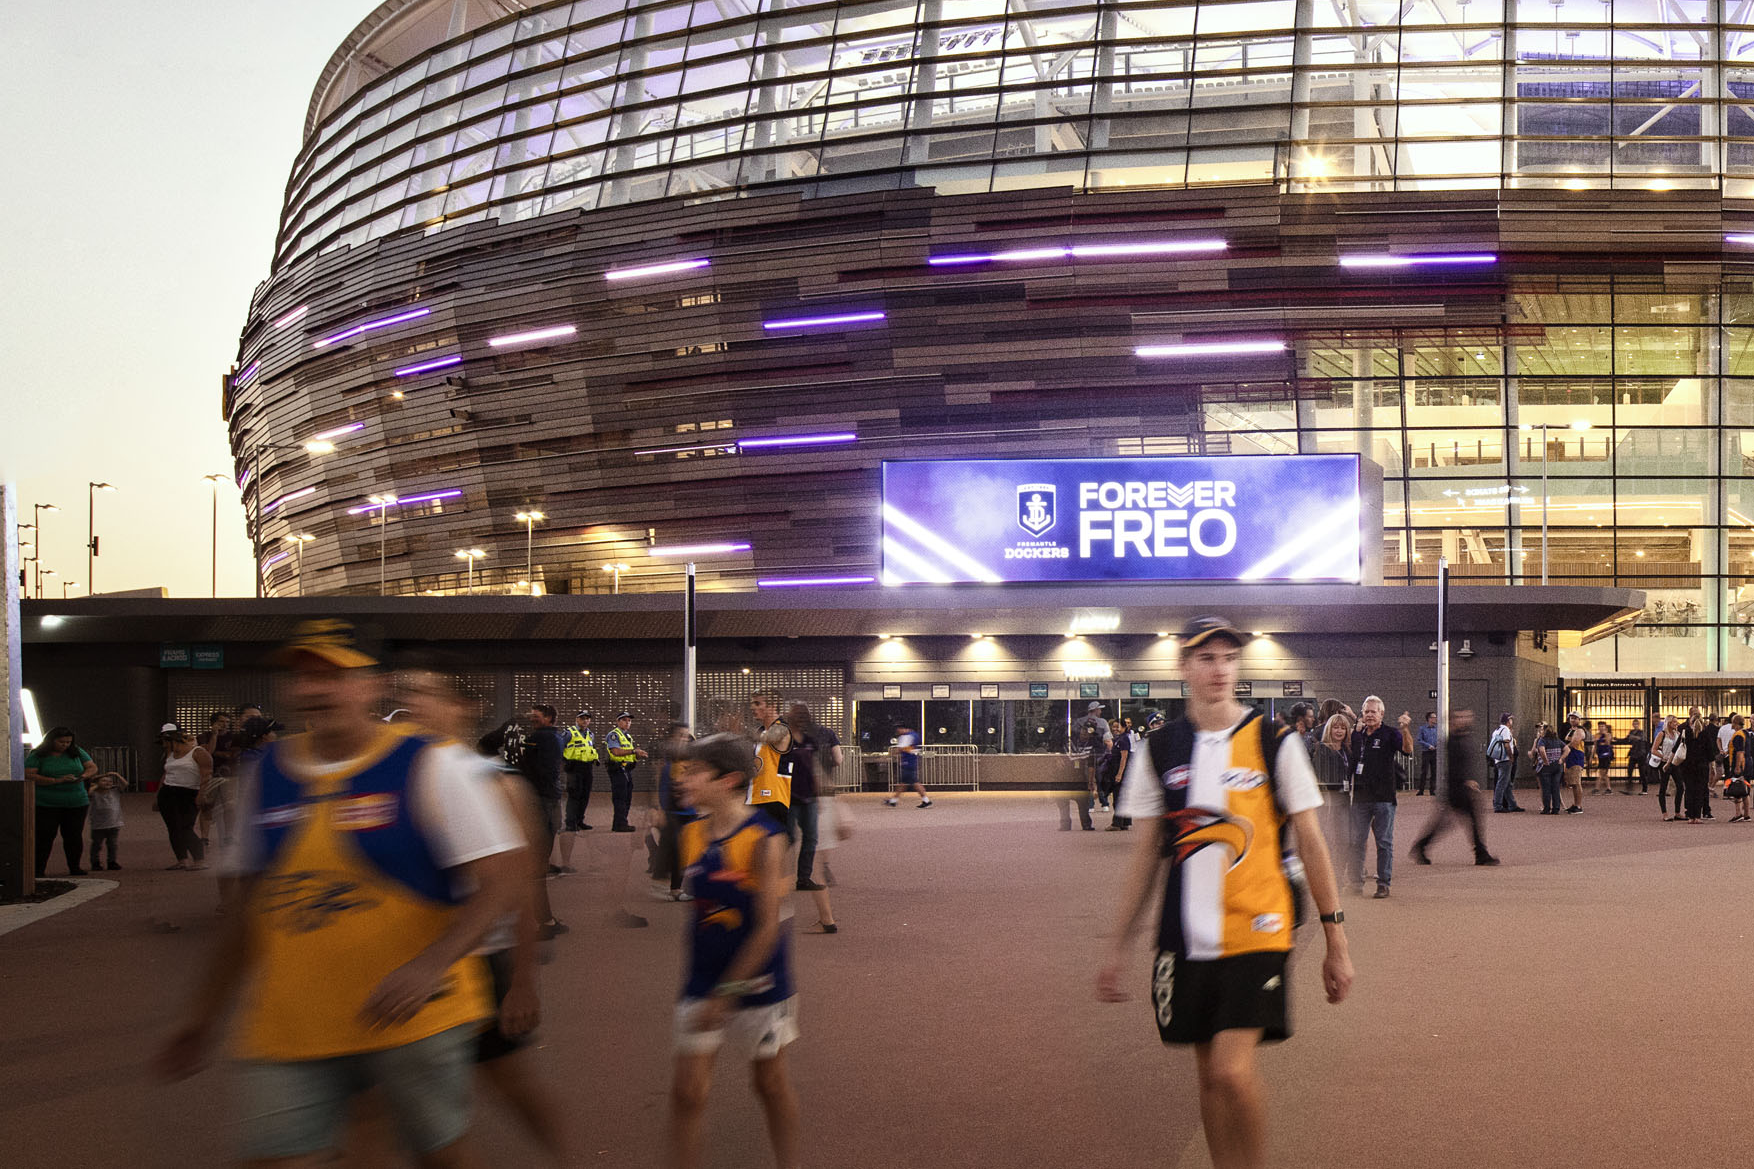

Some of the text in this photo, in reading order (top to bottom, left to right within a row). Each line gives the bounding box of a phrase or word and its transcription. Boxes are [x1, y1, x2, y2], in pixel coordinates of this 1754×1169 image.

[1079, 480, 1237, 509] FOREVER
[1079, 508, 1237, 558] FREO
[1004, 547, 1070, 559] DOCKERS
